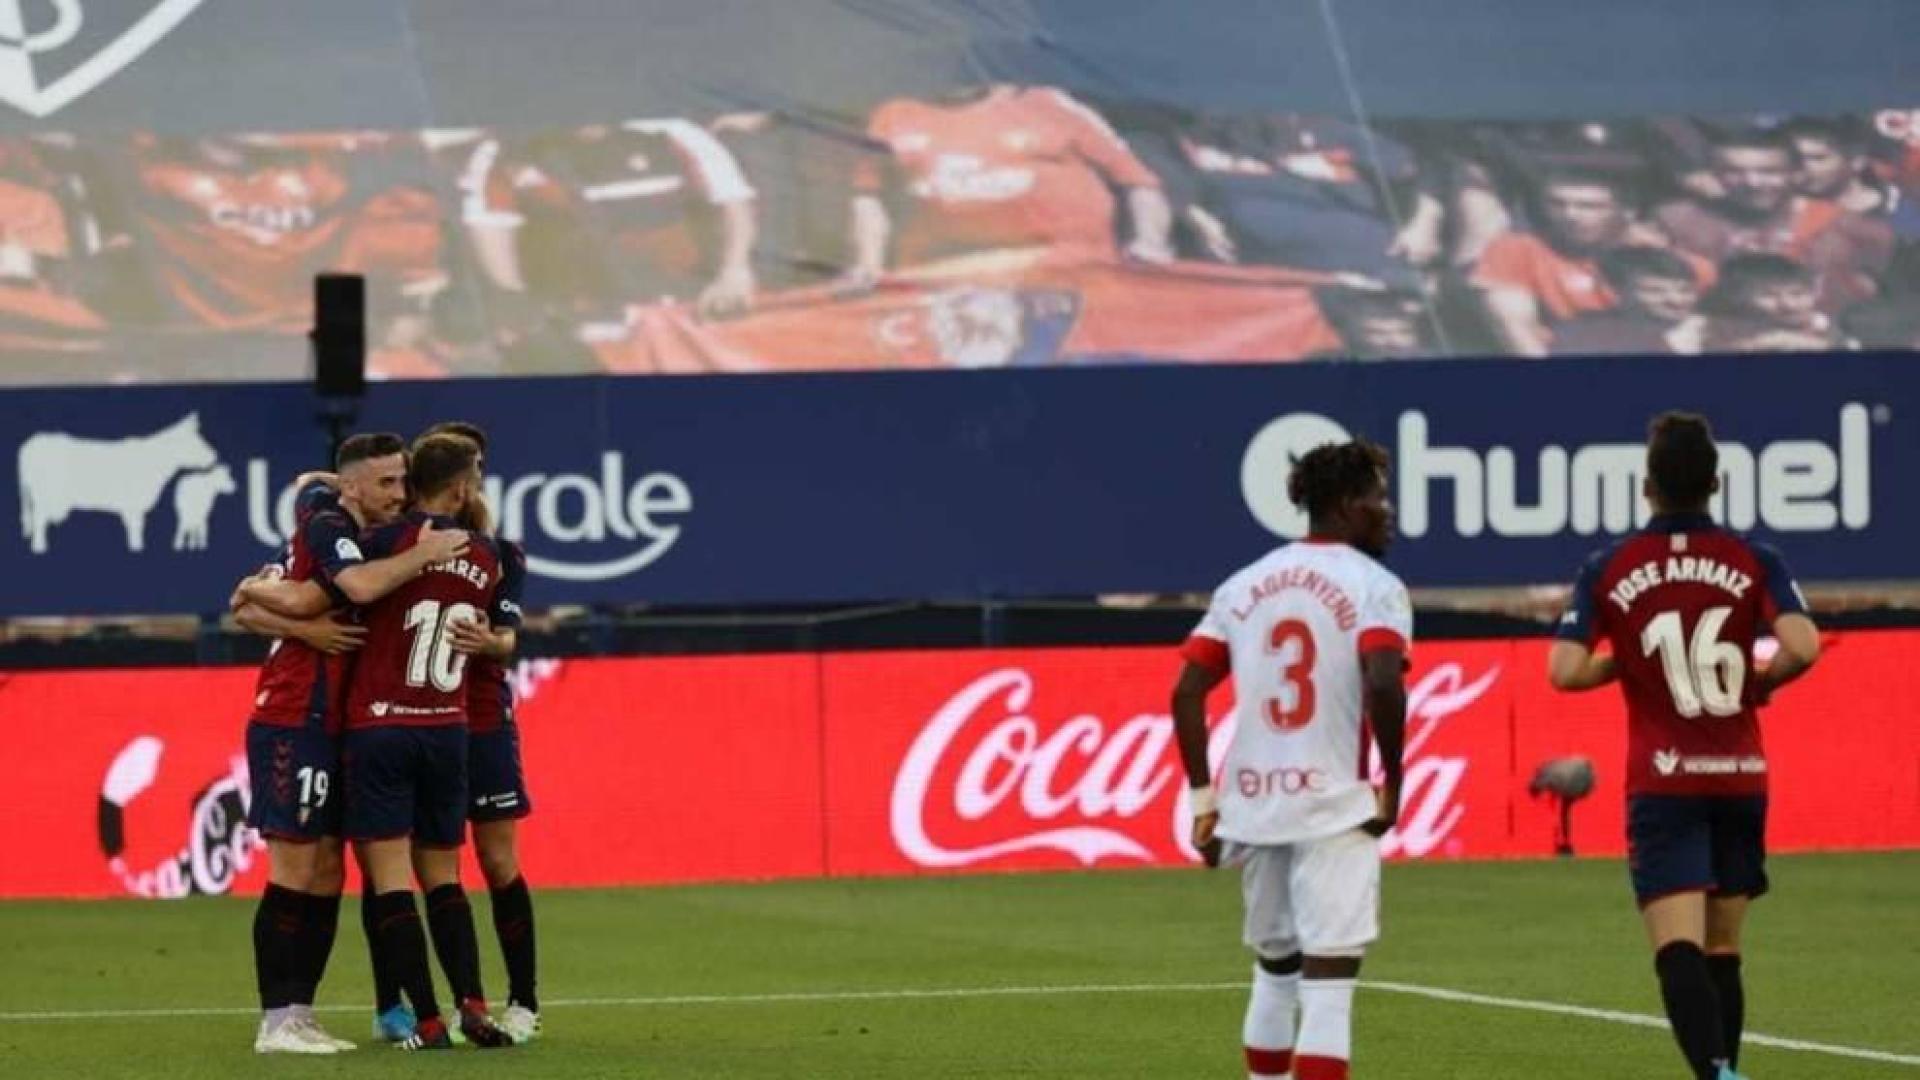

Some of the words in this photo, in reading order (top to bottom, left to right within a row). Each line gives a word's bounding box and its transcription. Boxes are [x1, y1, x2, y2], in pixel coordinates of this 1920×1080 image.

[1607, 561, 1662, 613] JOSE
[1665, 557, 1753, 598] ARNAIZ
[1264, 617, 1317, 735] 3
[1640, 606, 1746, 719] 16
[297, 765, 330, 808] 19
